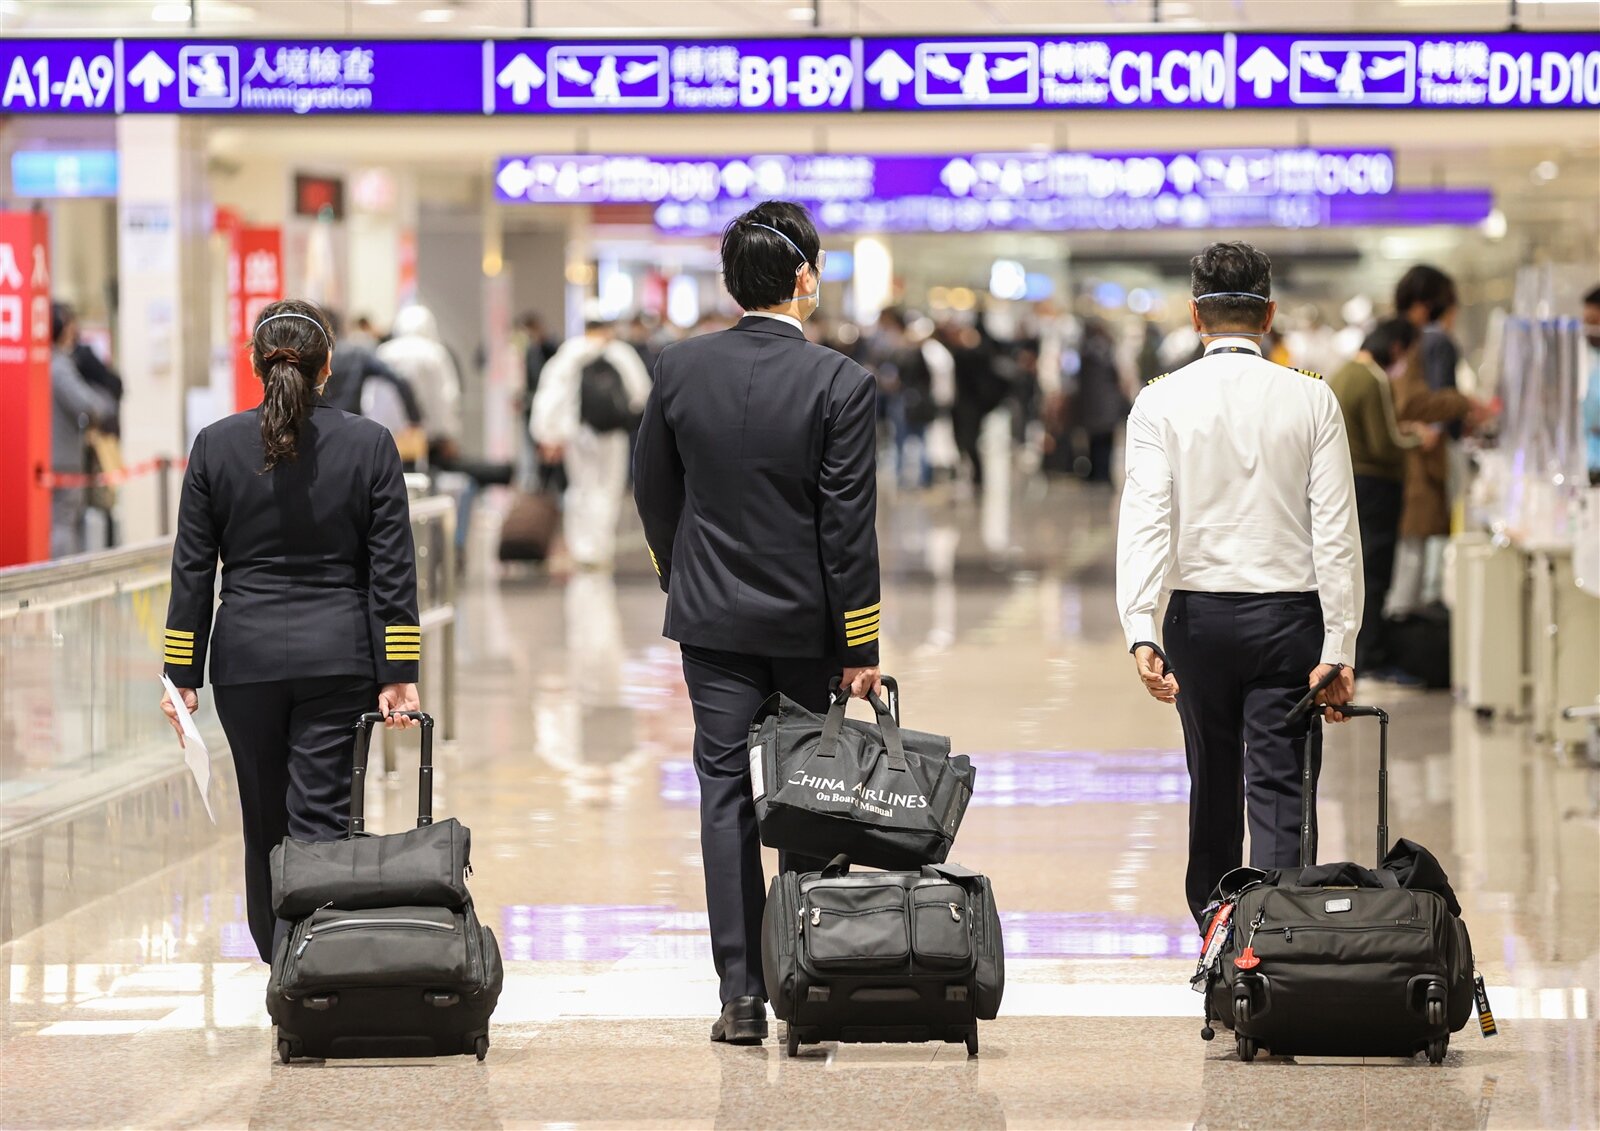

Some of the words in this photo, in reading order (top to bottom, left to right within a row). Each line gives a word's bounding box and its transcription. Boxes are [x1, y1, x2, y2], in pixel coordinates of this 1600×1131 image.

[2, 55, 114, 107] A1-A9
[241, 82, 372, 114] Immigration
[739, 54, 853, 107] B1-B9
[1109, 49, 1225, 104] C1-C10
[1488, 51, 1600, 104] D1-D10
[788, 770, 845, 791] CHINA
[852, 782, 928, 809] AIRLINES
[816, 792, 830, 801] On
[832, 793, 859, 807] Board
[860, 802, 893, 817] Manual
